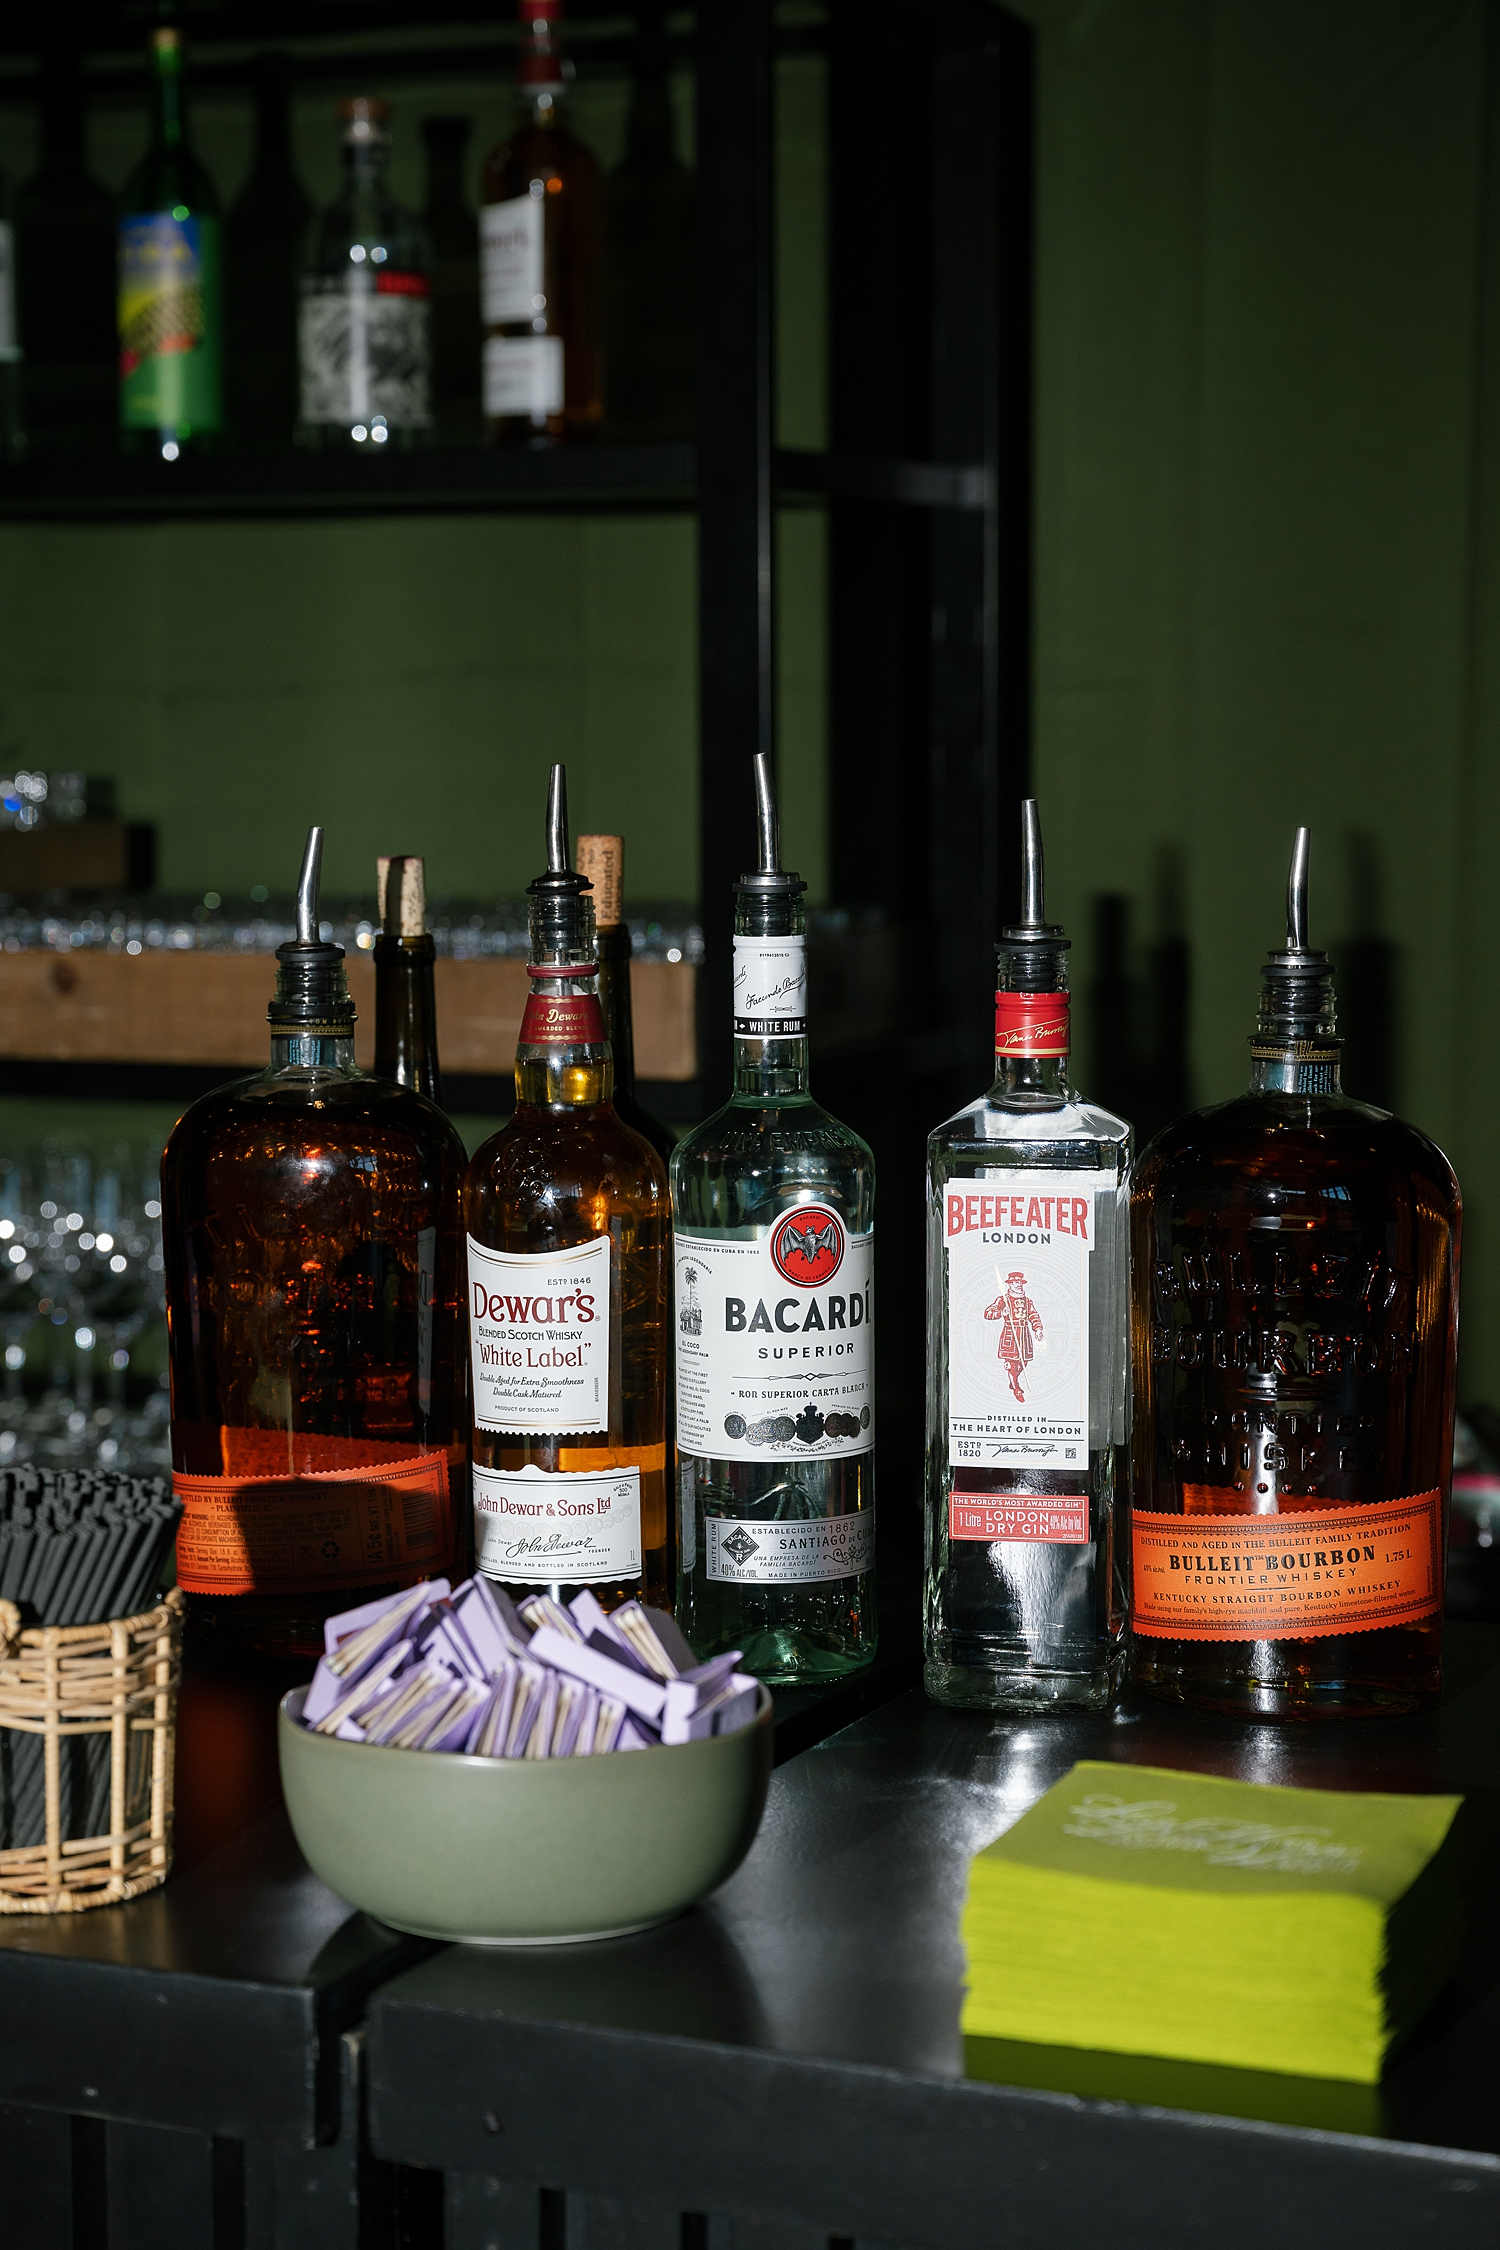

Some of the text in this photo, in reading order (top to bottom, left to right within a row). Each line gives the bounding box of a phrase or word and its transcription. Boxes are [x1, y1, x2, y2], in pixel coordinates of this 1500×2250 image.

[602, 850, 613, 919] Educated
[749, 1020, 801, 1032] WHITE RUM
[947, 1194, 1089, 1240] BEEFEATER
[982, 1231, 1051, 1246] LONDON
[570, 1276, 592, 1285] 1846
[788, 1268, 804, 1280] MARCA
[1153, 1248, 1413, 1311] BULLEIT
[472, 1281, 595, 1324] Dewar's
[725, 1278, 870, 1333] BACARDÍ
[478, 1325, 583, 1341] BLENDED SCOTCH WHISKY
[758, 1342, 854, 1360] SUPERIOR
[1151, 1323, 1416, 1378] BOURBON
[495, 1375, 510, 1386] Aged
[510, 1376, 521, 1388] for
[520, 1376, 540, 1386] Extra
[540, 1376, 585, 1388] Smoothness
[492, 1386, 562, 1398] Double Cask Matured
[738, 1382, 866, 1399] RON SUPERIOR CARTA BLANCA
[494, 1404, 518, 1412] PRODUCT
[952, 1423, 1081, 1435] THE HEART OF LONDON
[958, 1449, 981, 1458] 1820
[203, 1495, 213, 1503] BY
[214, 1496, 244, 1504] BULLEIT
[245, 1494, 286, 1504] FRONTIER
[477, 1492, 611, 1517] John Dewar & Sons Ltd
[970, 1498, 1002, 1506] WORLD'S
[216, 1505, 262, 1513] PLAINFIELD,
[367, 1503, 378, 1516] VT
[369, 1515, 381, 1531] ME,
[959, 1511, 963, 1527] 1
[965, 1511, 982, 1527] Litre
[985, 1510, 1049, 1523] LONDON
[752, 1527, 812, 1535] ESTABLECIDO
[829, 1521, 855, 1534] 1862
[985, 1523, 1049, 1535] DRY GIN
[779, 1533, 846, 1550] SANTIAGO
[848, 1535, 856, 1543] DE
[1140, 1536, 1179, 1548] DISTILLED
[1181, 1541, 1198, 1549] AND
[1201, 1541, 1228, 1549] AGED
[1244, 1539, 1266, 1549] THE
[1268, 1537, 1312, 1548] BULLEIT
[1315, 1532, 1353, 1545] FAMILY
[1356, 1523, 1412, 1540] TRADITION
[505, 1535, 544, 1559] John
[367, 1551, 384, 1564] IA
[629, 1549, 636, 1561] 1L
[736, 1553, 743, 1561] R
[1169, 1545, 1413, 1572] BULLEIT BOURBON 1.75 L
[576, 1560, 608, 1568] SCOTLAND
[720, 1563, 759, 1578] 40% ALC/VOL.
[1185, 1567, 1357, 1585] FRONTIER WHISKEY
[1153, 1579, 1401, 1604] KENTUCKY STRAIGHT BOURBON WHISKEY
[1143, 1602, 1157, 1611] Made
[1156, 1605, 1172, 1613] using
[1183, 1607, 1208, 1615] family's
[1208, 1607, 1236, 1615] high-rye
[1304, 1601, 1337, 1611] Kentucky
[1338, 1592, 1398, 1607] limestone-filtered
